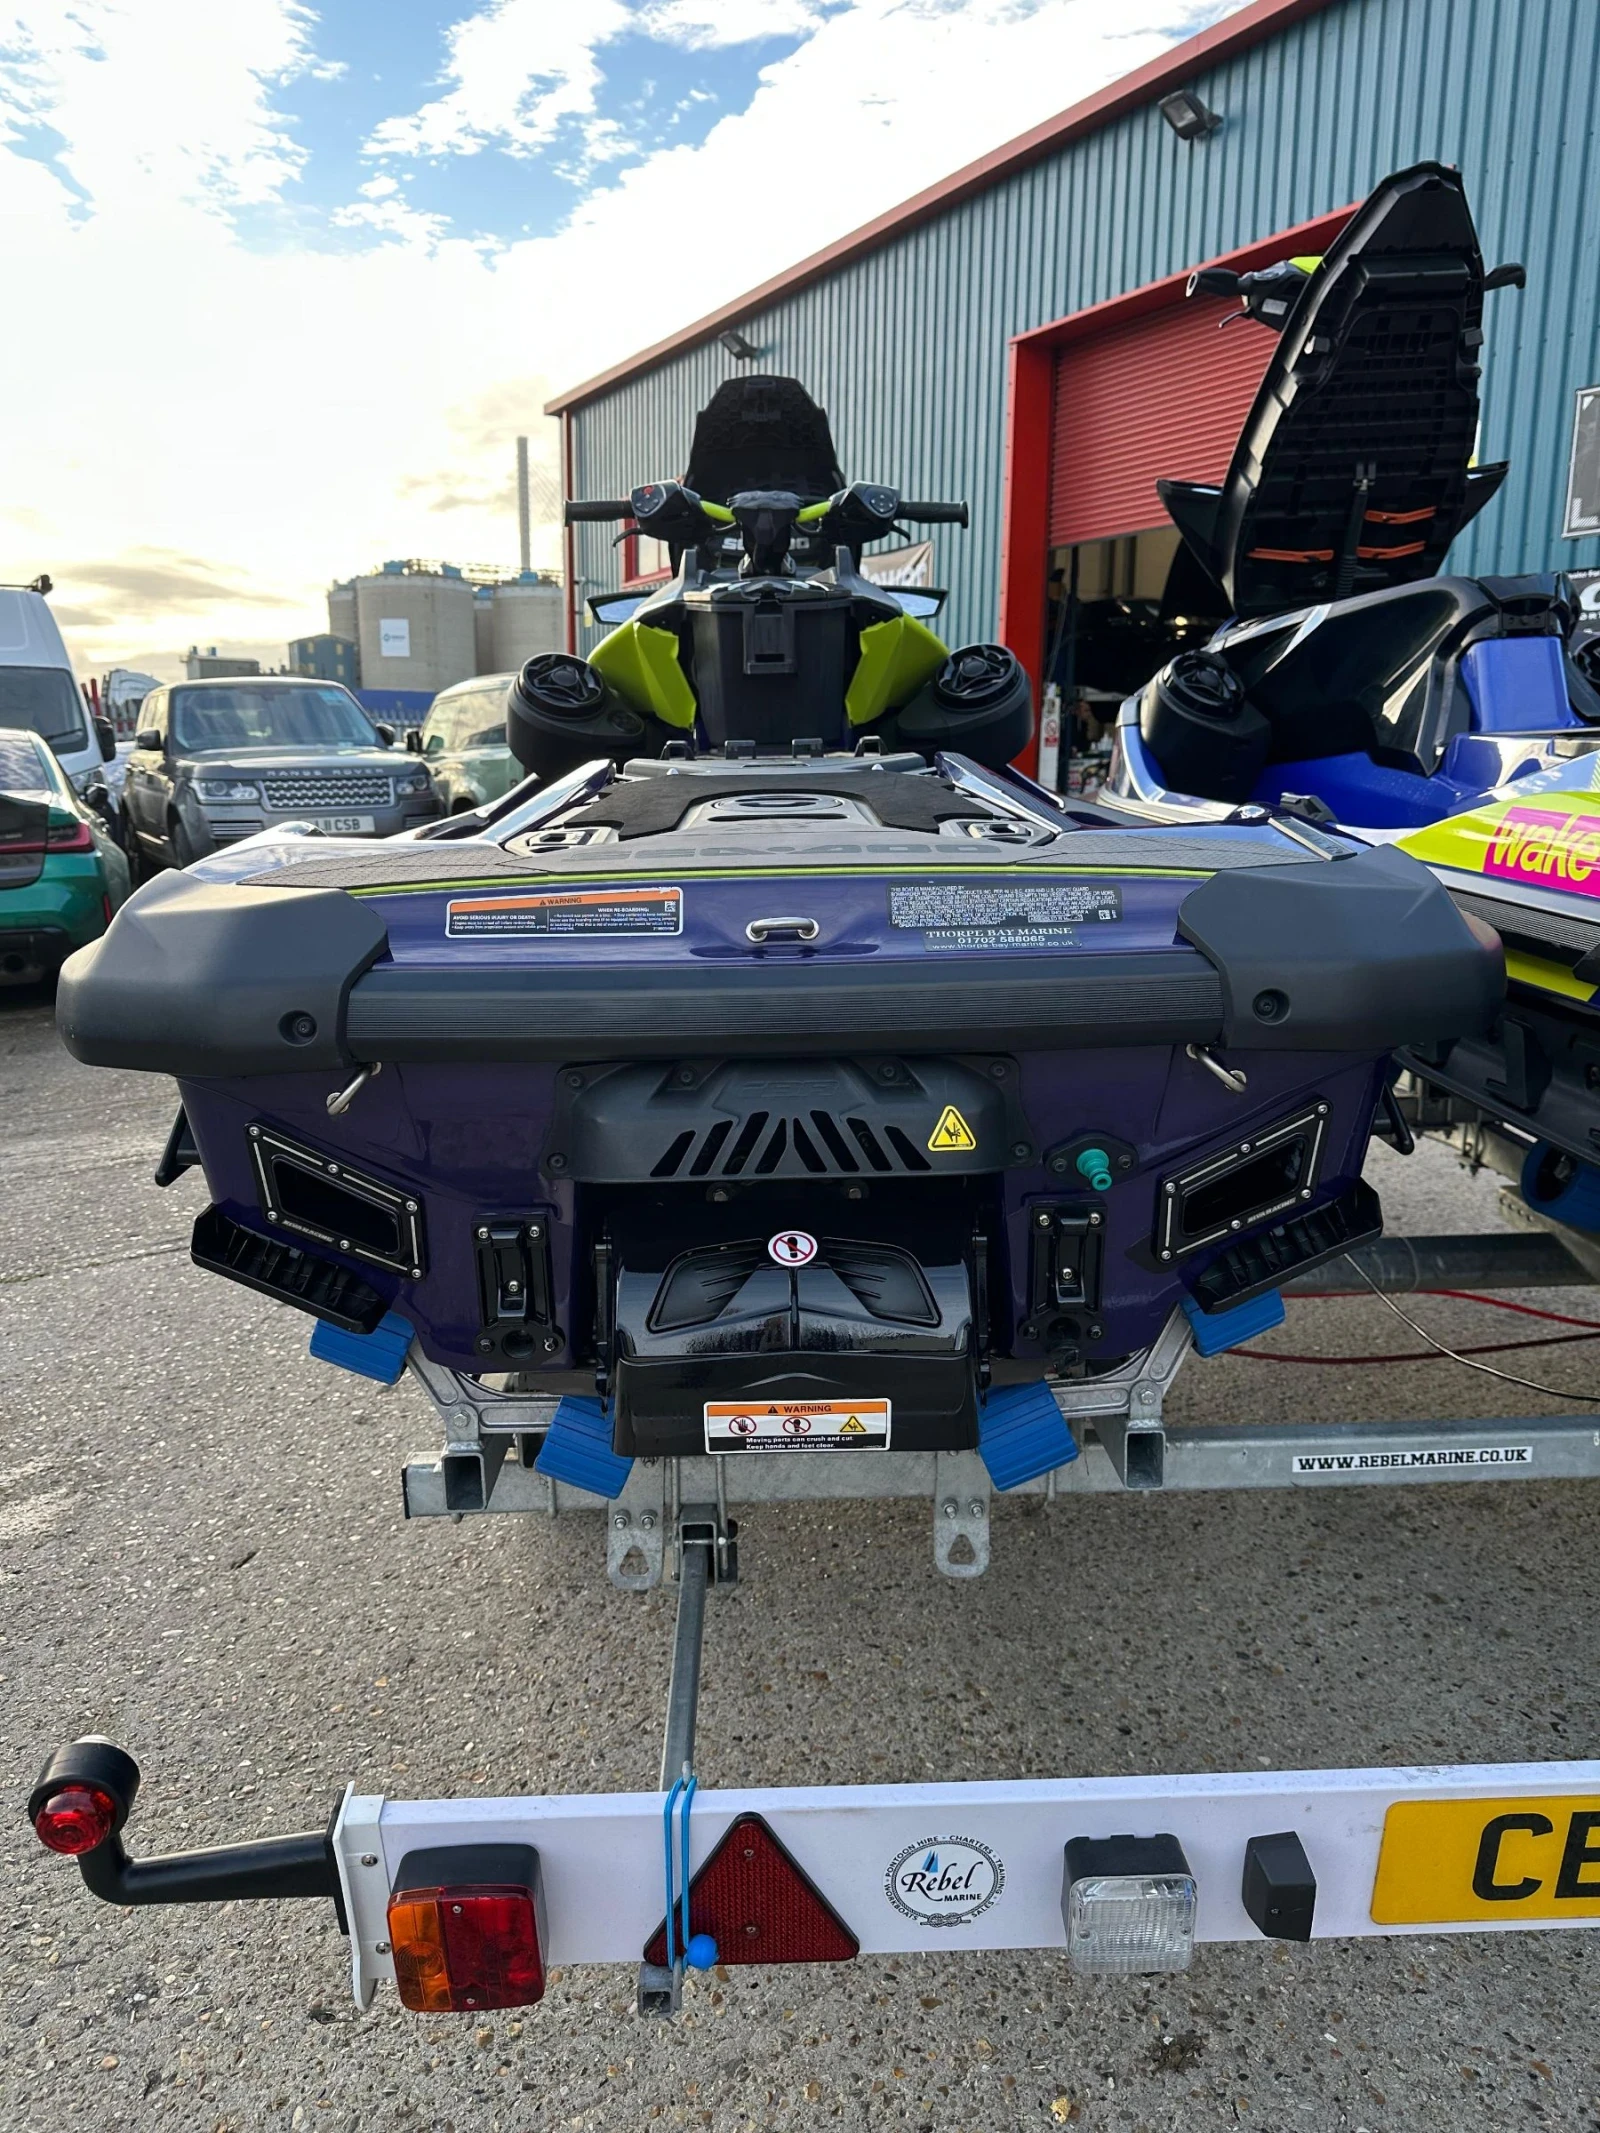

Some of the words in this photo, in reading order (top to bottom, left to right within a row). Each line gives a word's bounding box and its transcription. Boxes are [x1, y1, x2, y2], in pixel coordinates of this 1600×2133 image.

[334, 818, 361, 831] CSB
[1491, 820, 1600, 882] wake
[547, 897, 582, 905] WARNING
[926, 930, 984, 938] THORPE
[988, 929, 1014, 937] BAY
[1018, 927, 1072, 936] MARINE
[1000, 935, 1045, 943] 588065
[1266, 1196, 1296, 1214] RACING
[784, 1405, 832, 1413] WARNING
[1298, 1449, 1528, 1470] WWW.REBELMARINE.CO.UK
[949, 1835, 993, 1854] CHARTERS
[885, 1844, 916, 1878] PONTOON
[917, 1835, 939, 1847] HIRE
[900, 1861, 984, 1902] Rebel
[994, 1858, 1006, 1895] TRAINING
[884, 1883, 918, 1921] WORKBOATS
[944, 1893, 982, 1902] MARINE
[971, 1900, 994, 1918] SALES
